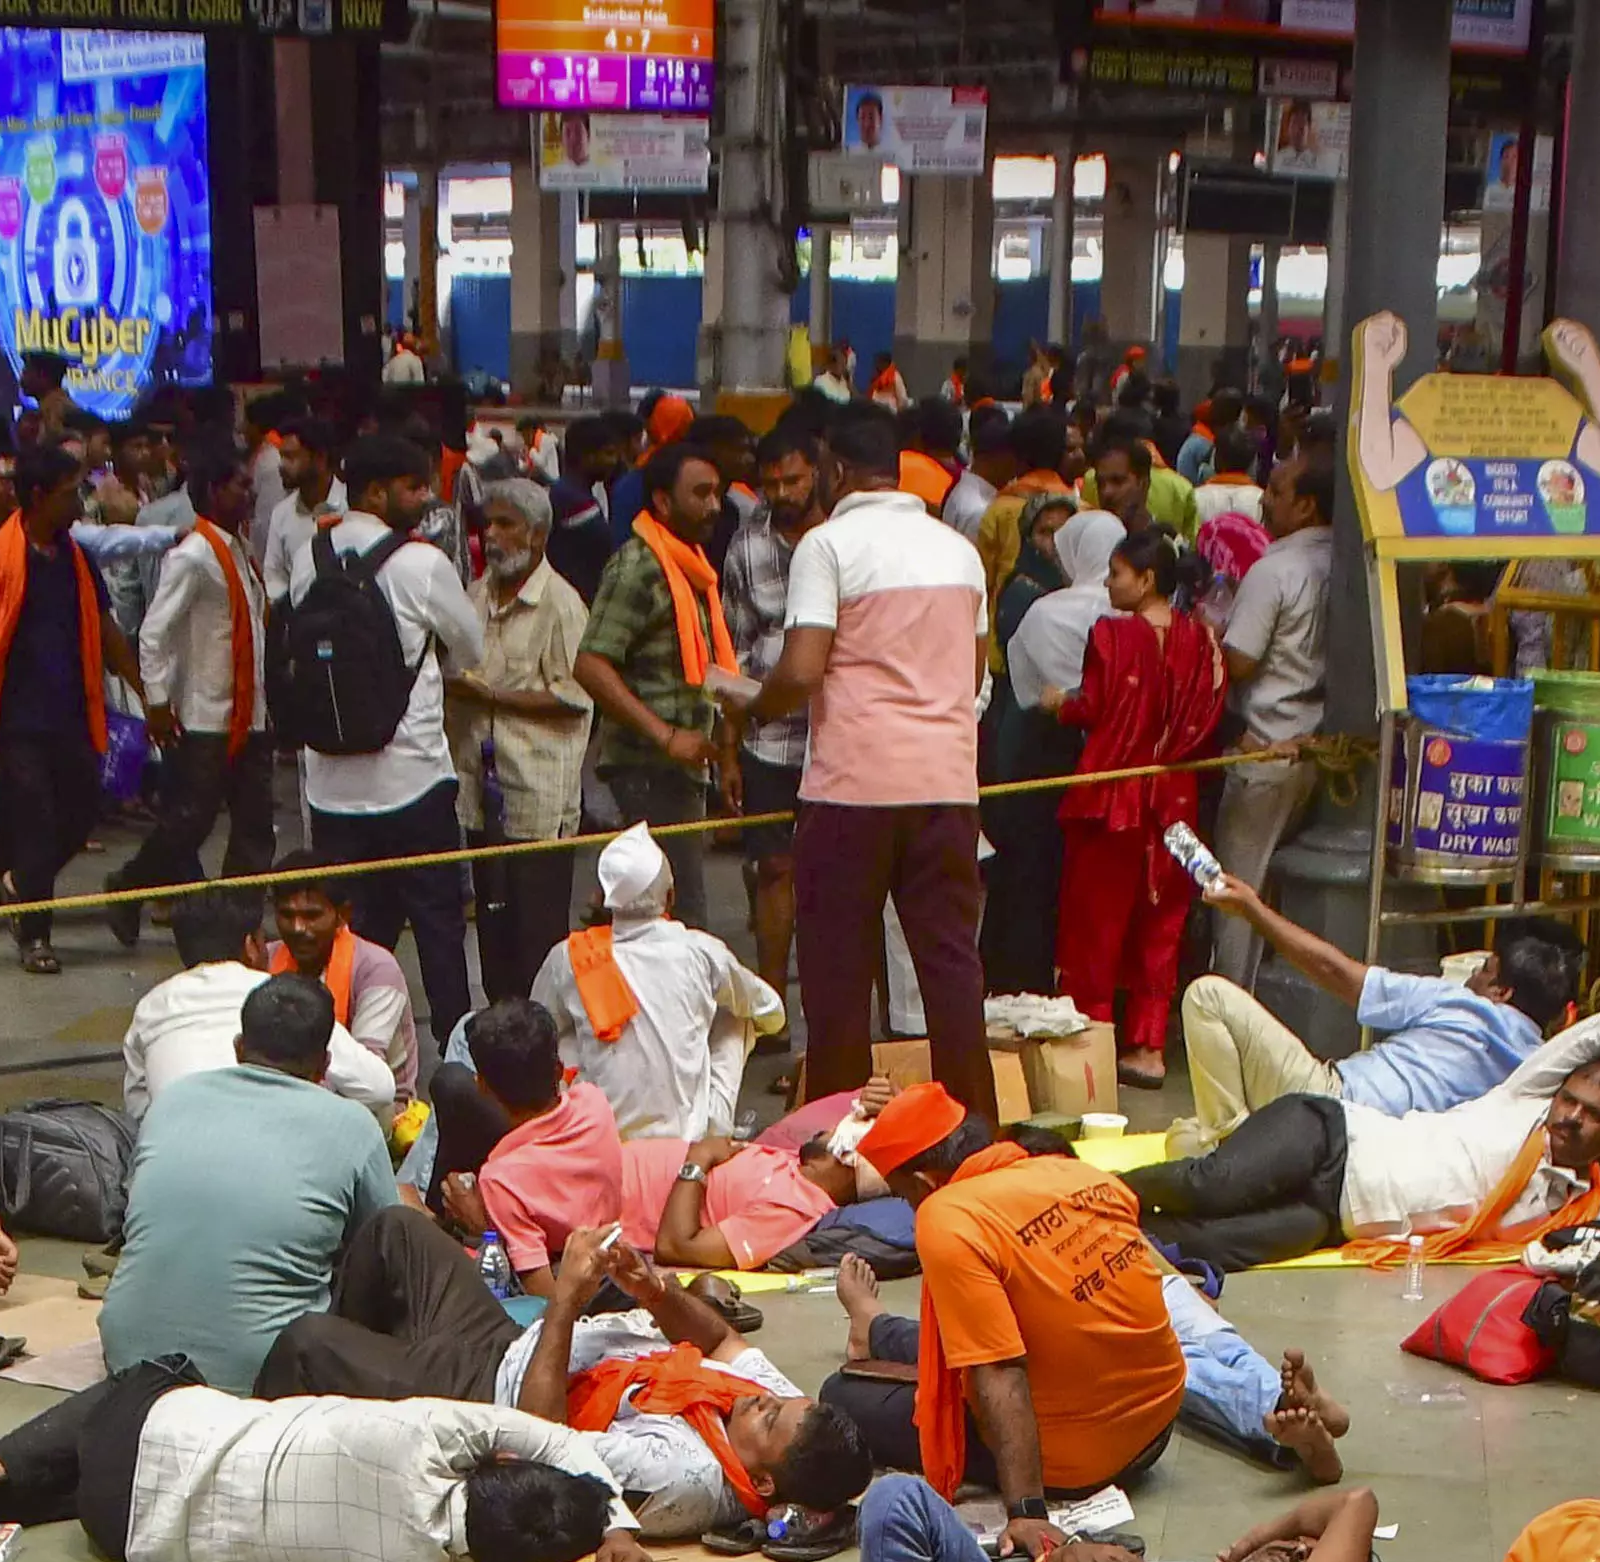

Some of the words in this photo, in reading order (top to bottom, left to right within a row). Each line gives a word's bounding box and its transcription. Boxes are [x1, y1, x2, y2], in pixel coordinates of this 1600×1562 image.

[342, 2, 383, 29] NOW
[15, 305, 150, 368] MuCyber
[1439, 831, 1479, 853] DRY
[1015, 1199, 1069, 1248] मराठा
[1070, 1267, 1106, 1303] बीड
